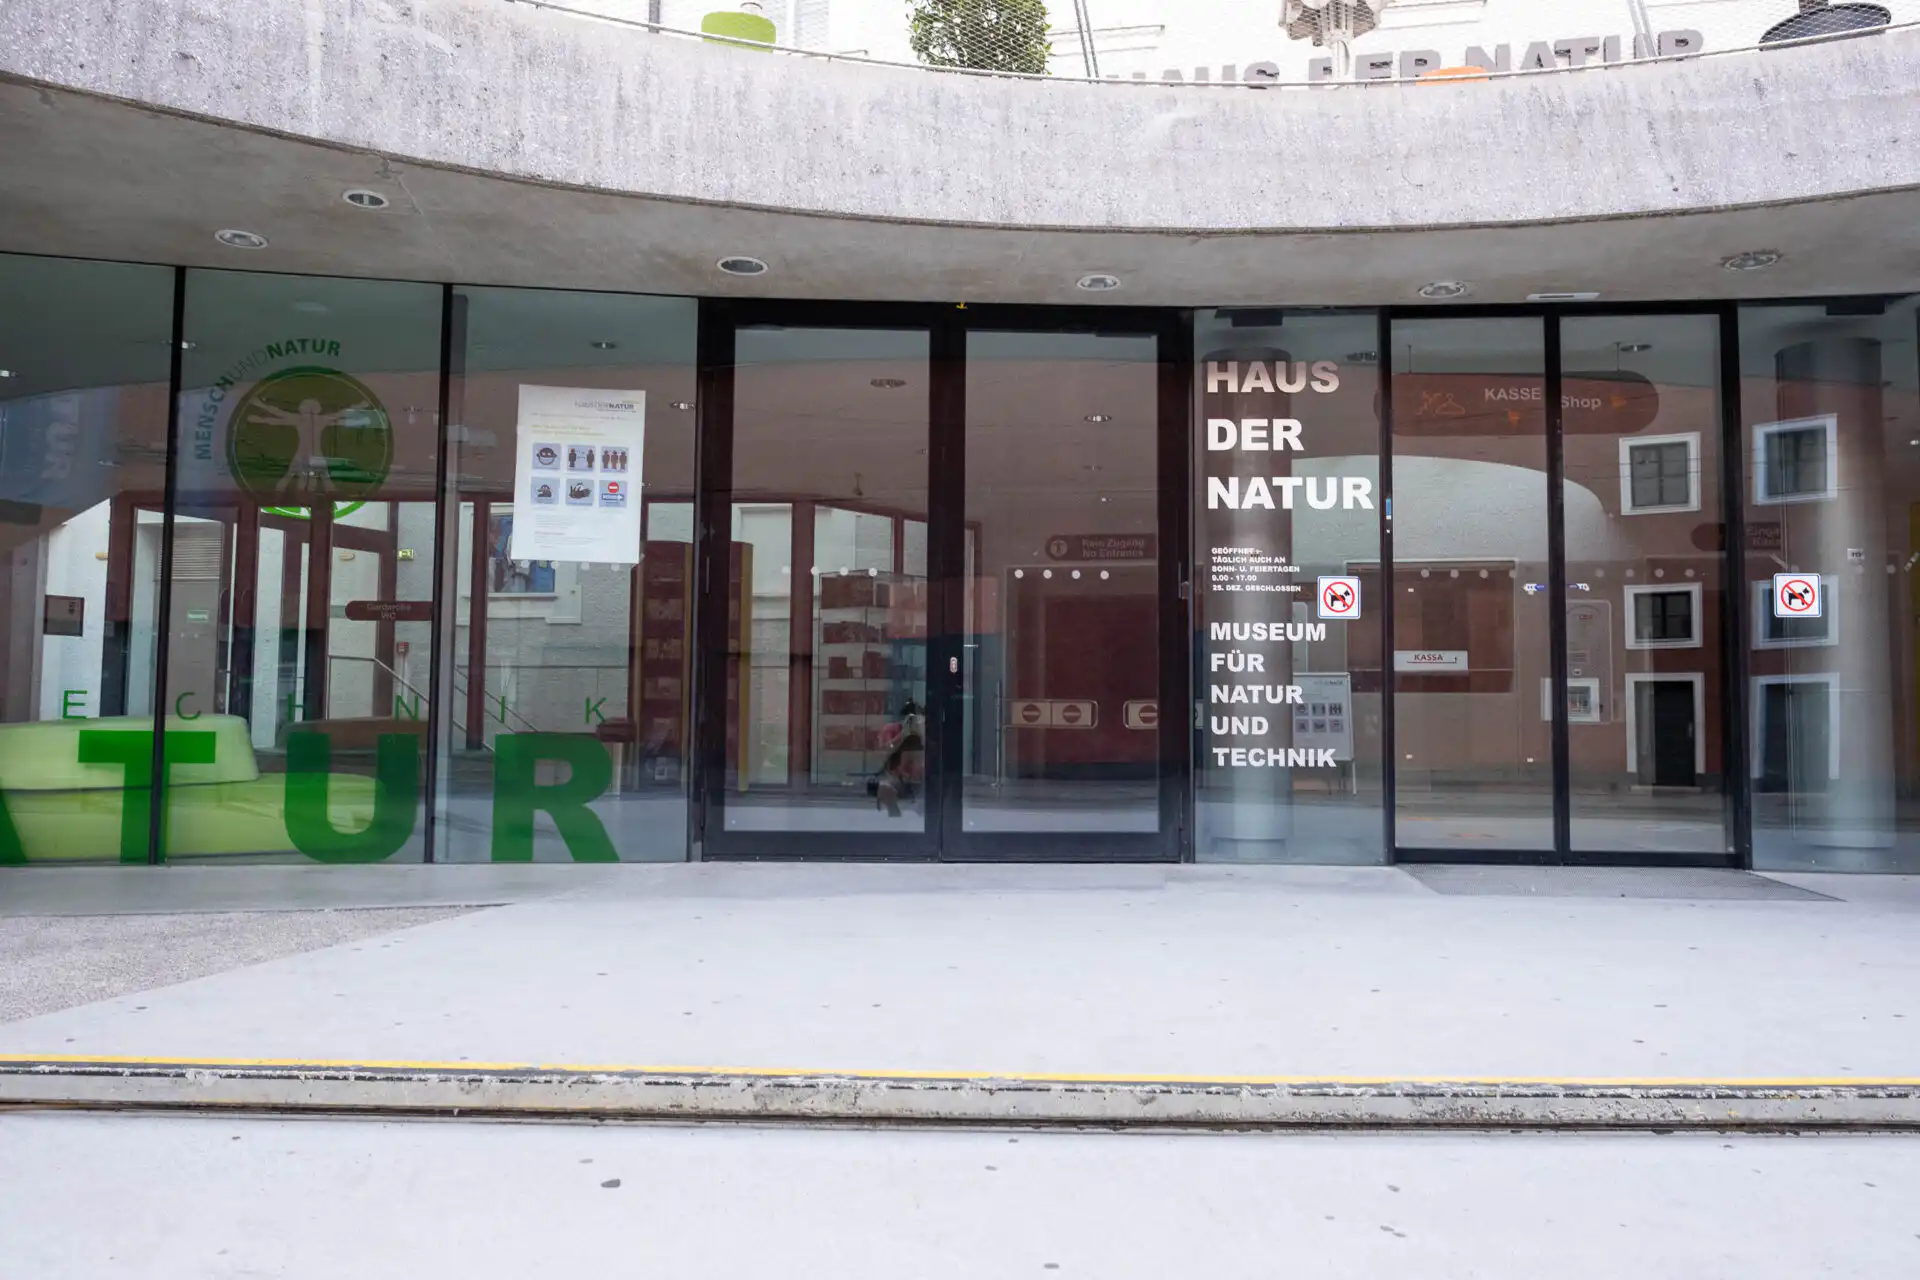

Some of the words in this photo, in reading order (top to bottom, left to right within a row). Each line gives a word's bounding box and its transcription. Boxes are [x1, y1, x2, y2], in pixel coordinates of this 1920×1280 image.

[1207, 360, 1340, 393] HAUS
[1484, 387, 1542, 402] KASSE
[1207, 418, 1305, 451] DER
[1207, 476, 1374, 510] NATUR
[1245, 584, 1302, 592] GESCHLOSSEN
[1210, 622, 1326, 642] MUSEUM
[1210, 649, 1265, 672] FÜR
[1414, 653, 1444, 662] KASSA
[1210, 684, 1304, 704] NATUR
[1210, 716, 1269, 736] UND
[1212, 747, 1337, 768] TECHNIK
